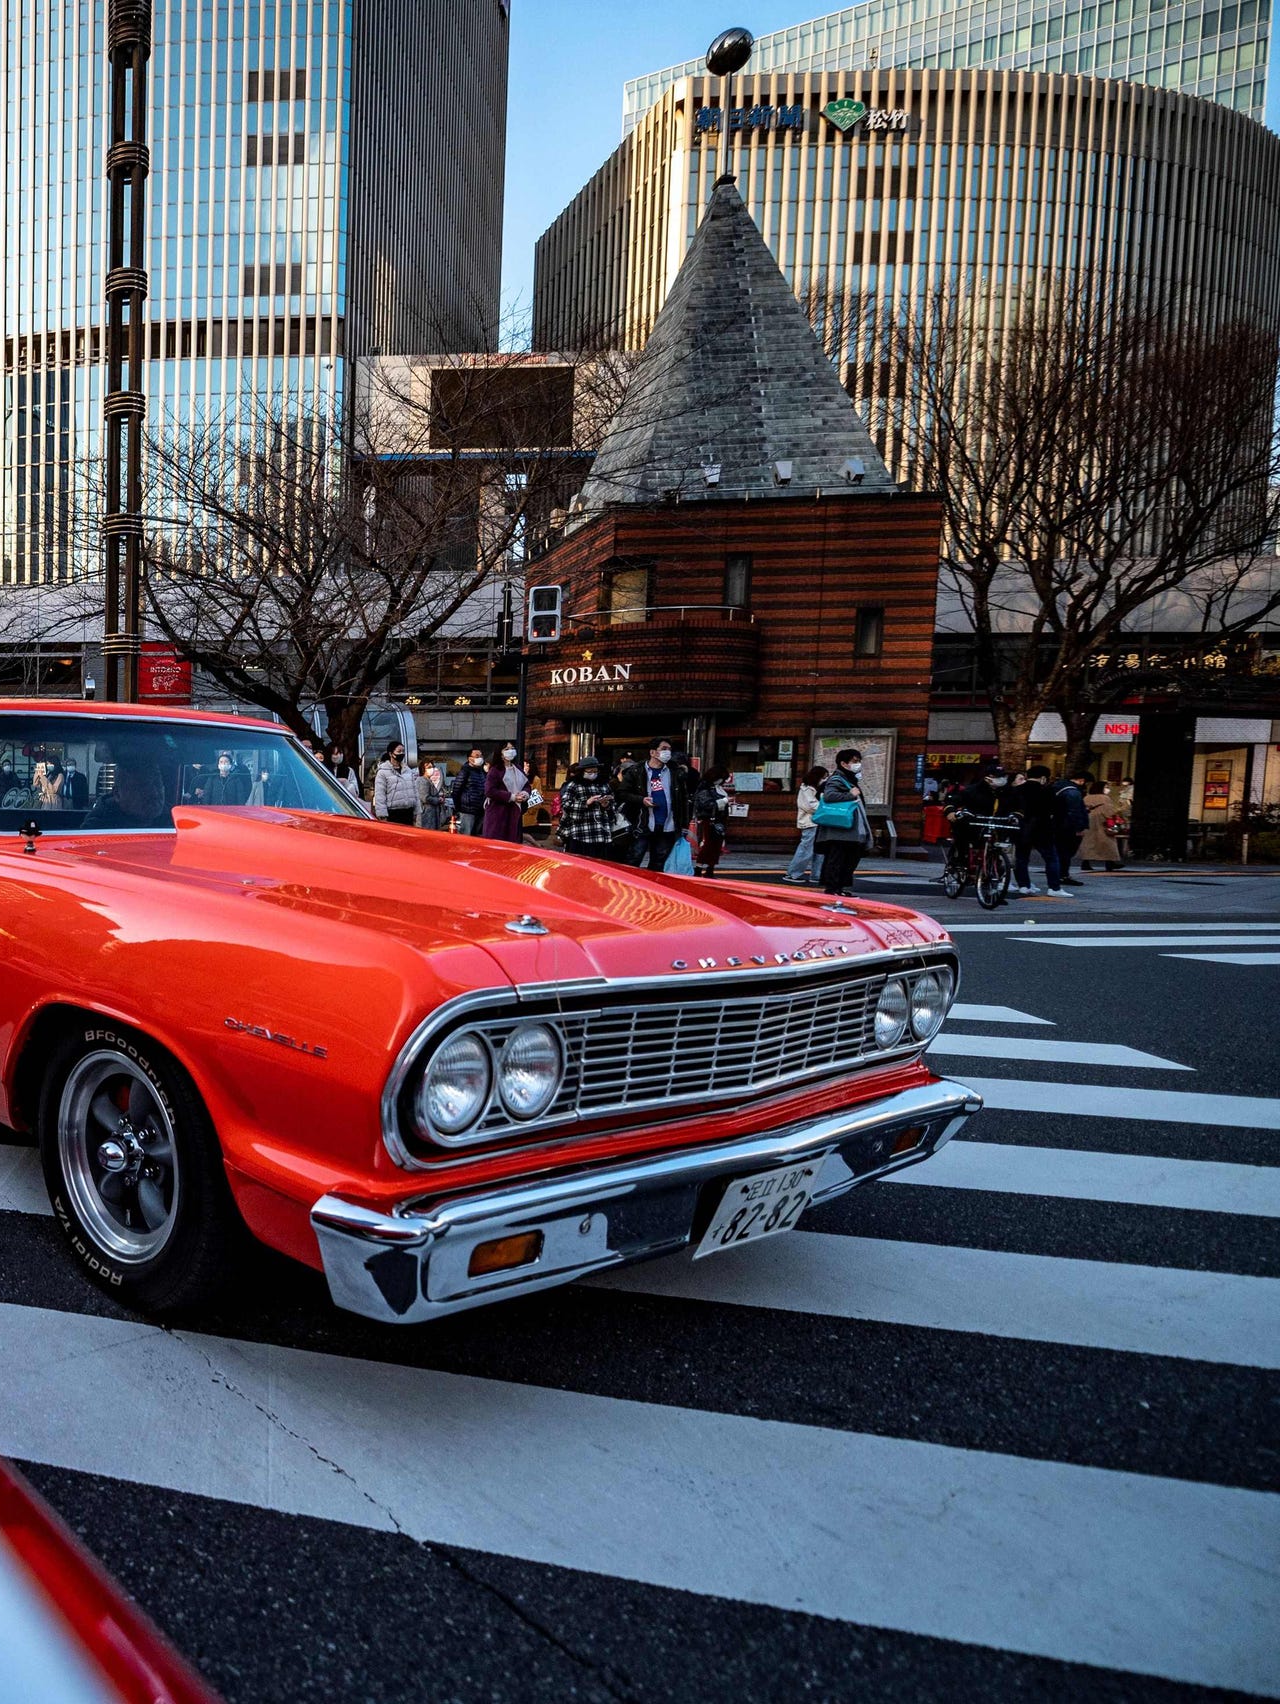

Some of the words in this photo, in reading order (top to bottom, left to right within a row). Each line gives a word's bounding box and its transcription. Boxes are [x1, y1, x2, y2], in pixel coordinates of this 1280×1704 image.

[696, 104, 802, 132] 朝日新聞
[867, 108, 910, 130] 松竹
[550, 663, 632, 685] KOBAN
[672, 944, 849, 970] CHEVROLET
[84, 1029, 176, 1125] BFGoodrich
[745, 1179, 777, 1201] 足立
[777, 1169, 805, 1193] 130
[54, 1195, 72, 1232] T/A
[721, 1190, 806, 1244] 82-82
[71, 1236, 123, 1286] Radial
